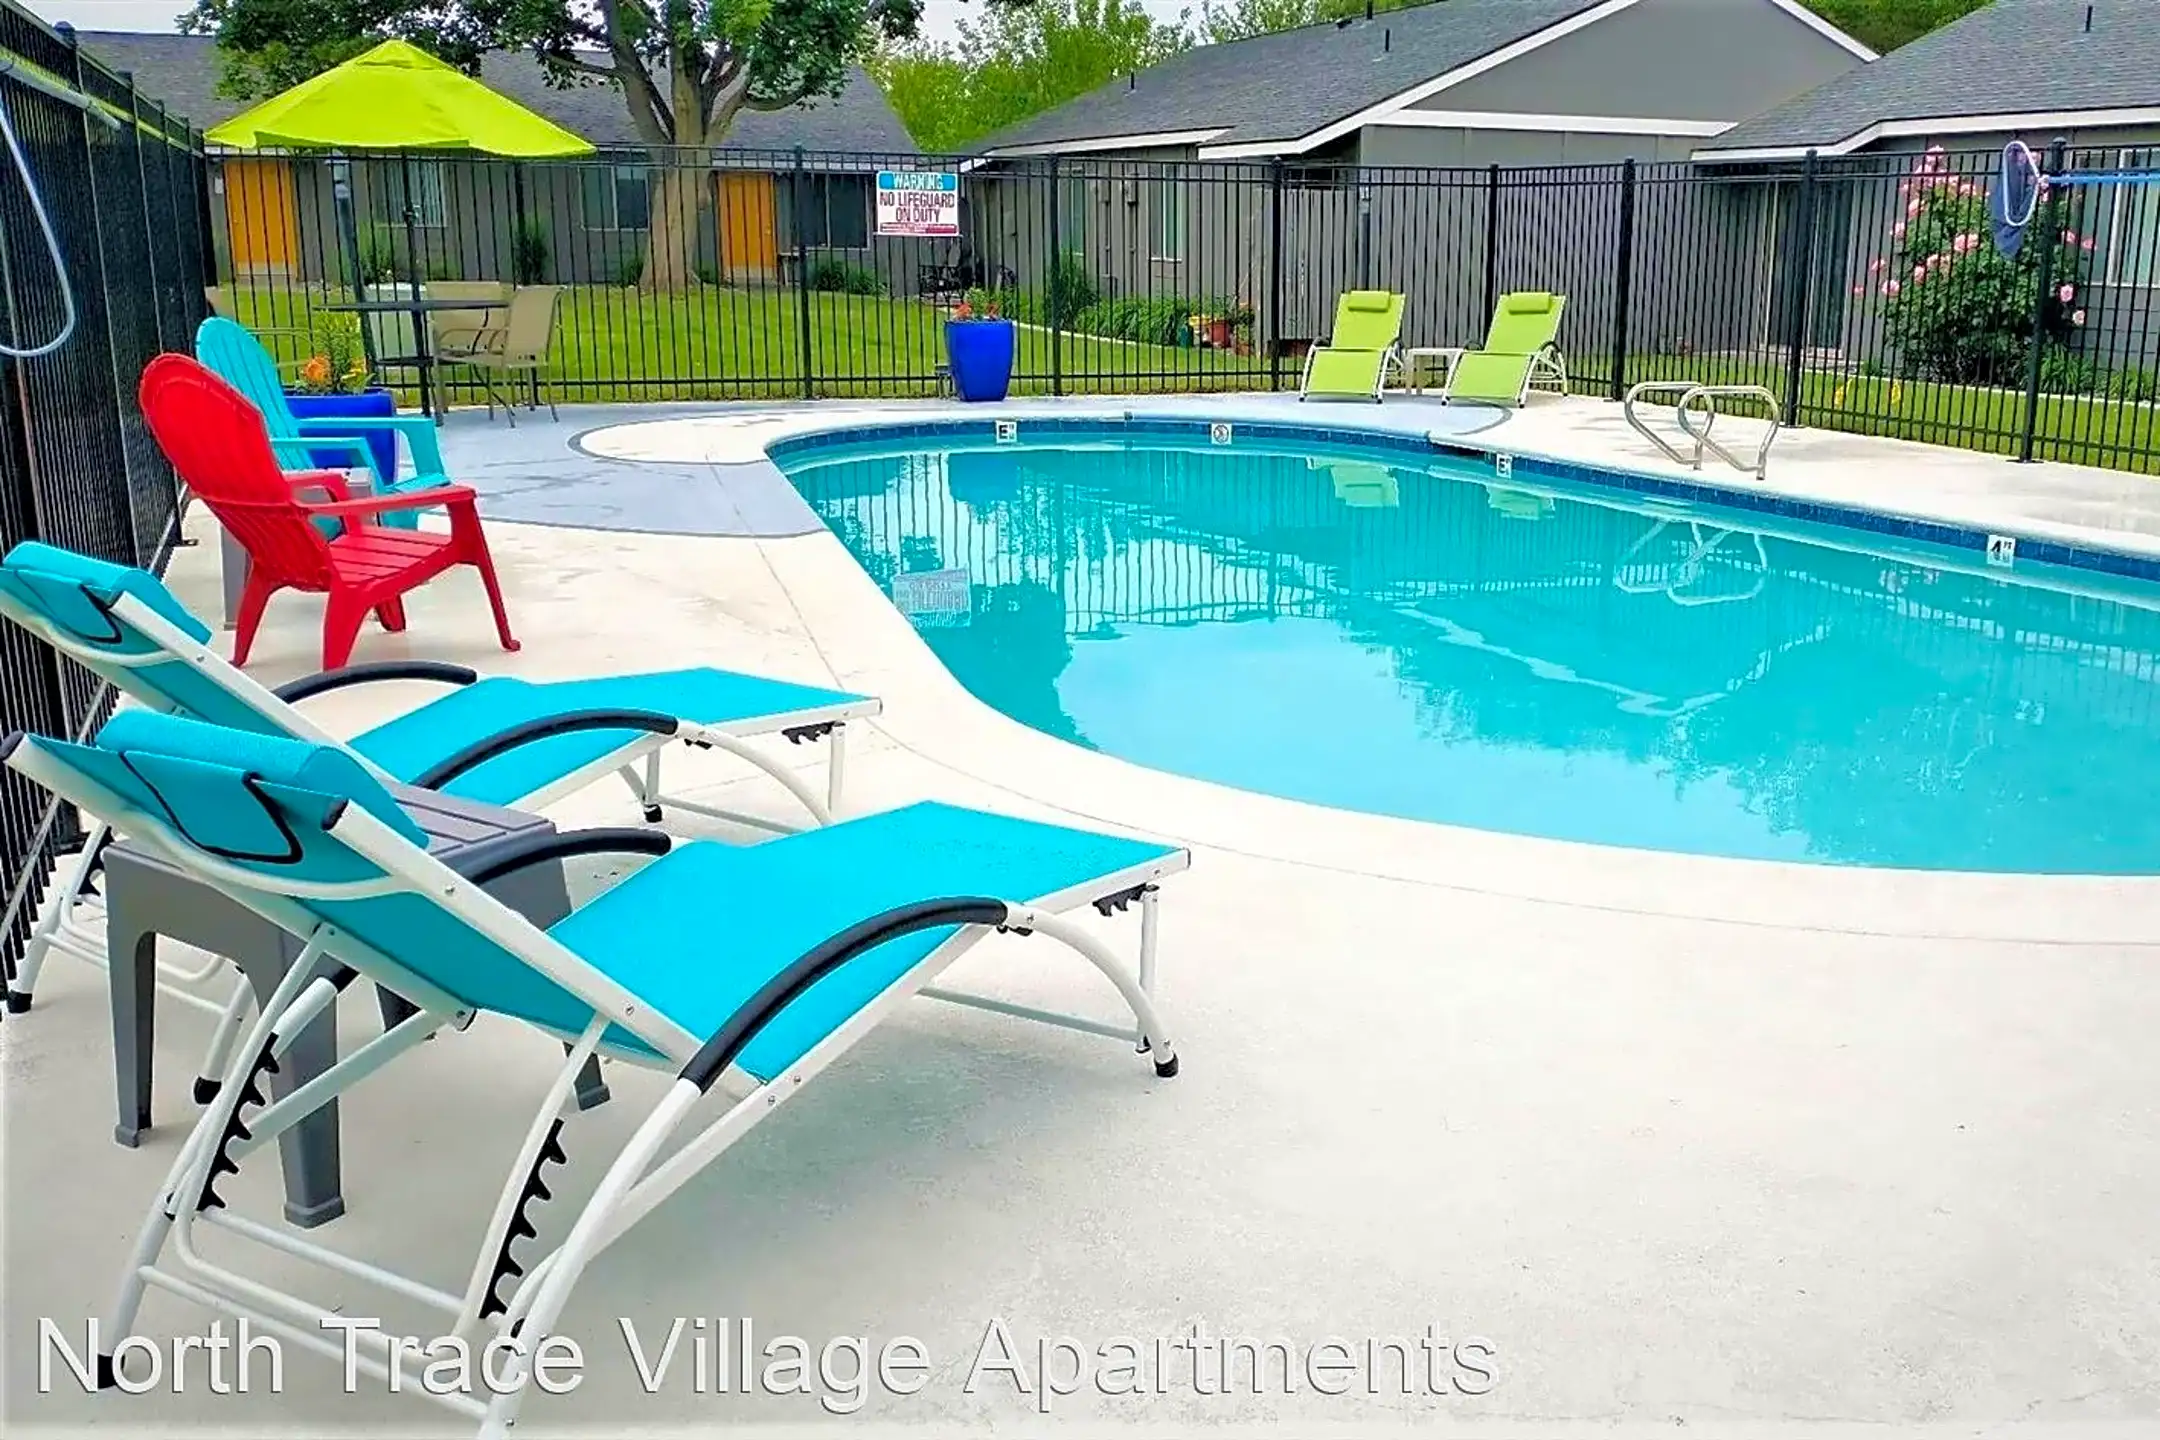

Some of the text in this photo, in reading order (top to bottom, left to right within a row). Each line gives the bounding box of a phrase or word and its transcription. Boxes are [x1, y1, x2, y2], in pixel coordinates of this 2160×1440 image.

[893, 173, 944, 189] WARNING
[880, 191, 955, 208] NO LIFEGUARD
[896, 207, 940, 223] ON DUTY
